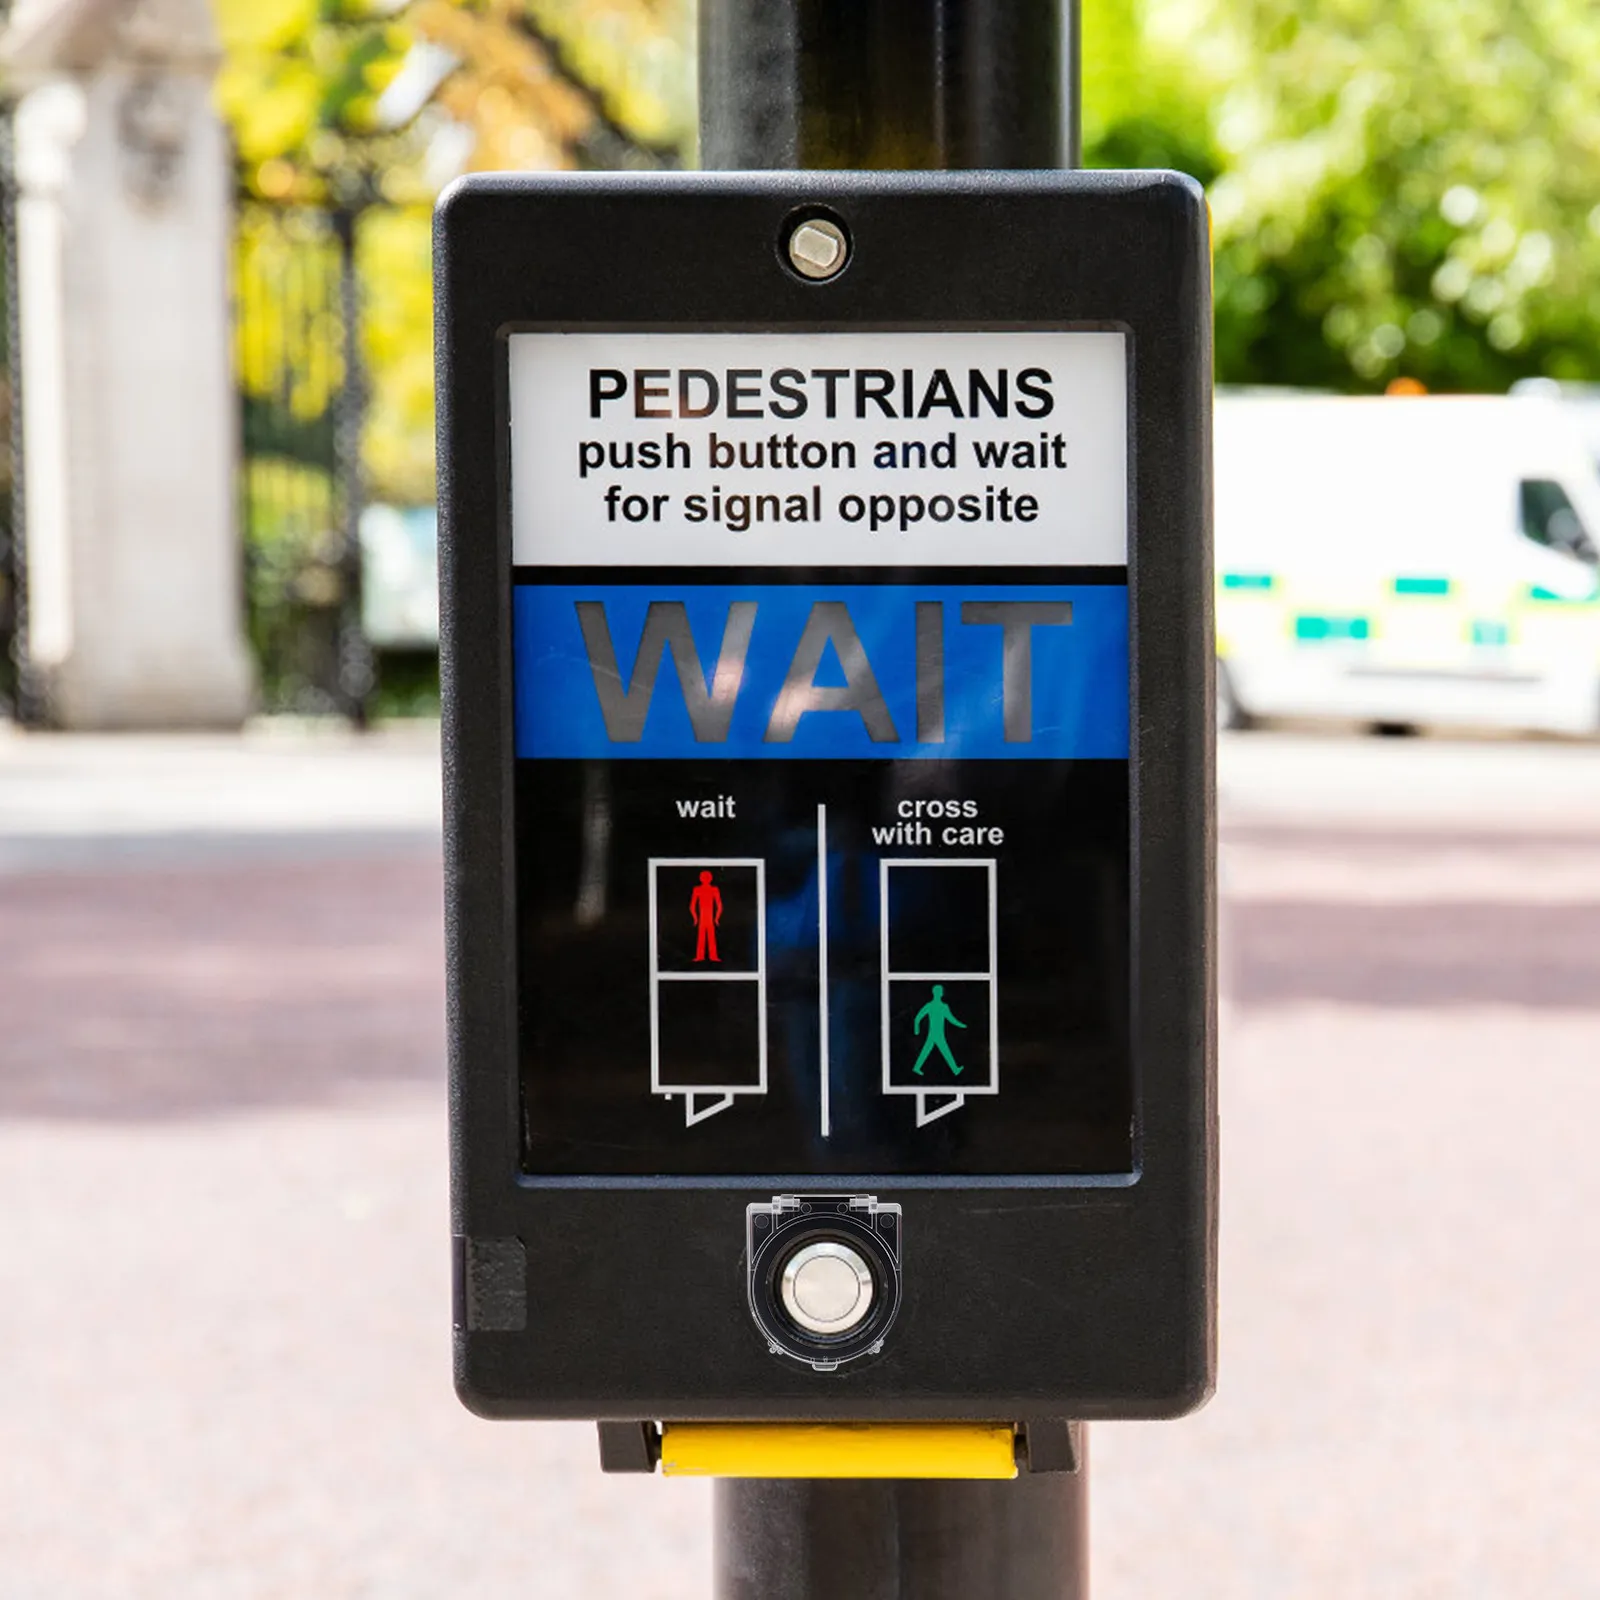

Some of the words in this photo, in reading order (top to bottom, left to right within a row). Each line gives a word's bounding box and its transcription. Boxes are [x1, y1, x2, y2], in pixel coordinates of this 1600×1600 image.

[588, 367, 1055, 420] PEDESTRIANS
[578, 432, 692, 479] push
[708, 432, 857, 469] button
[873, 431, 957, 469] and
[972, 431, 1067, 469] wait
[603, 485, 670, 523] for
[684, 485, 821, 533] signal
[838, 485, 1040, 532] opposite
[574, 601, 1073, 744] WAIT
[675, 794, 736, 818] wait
[897, 799, 979, 818] cross
[871, 821, 932, 846] with
[941, 826, 1005, 846] care
